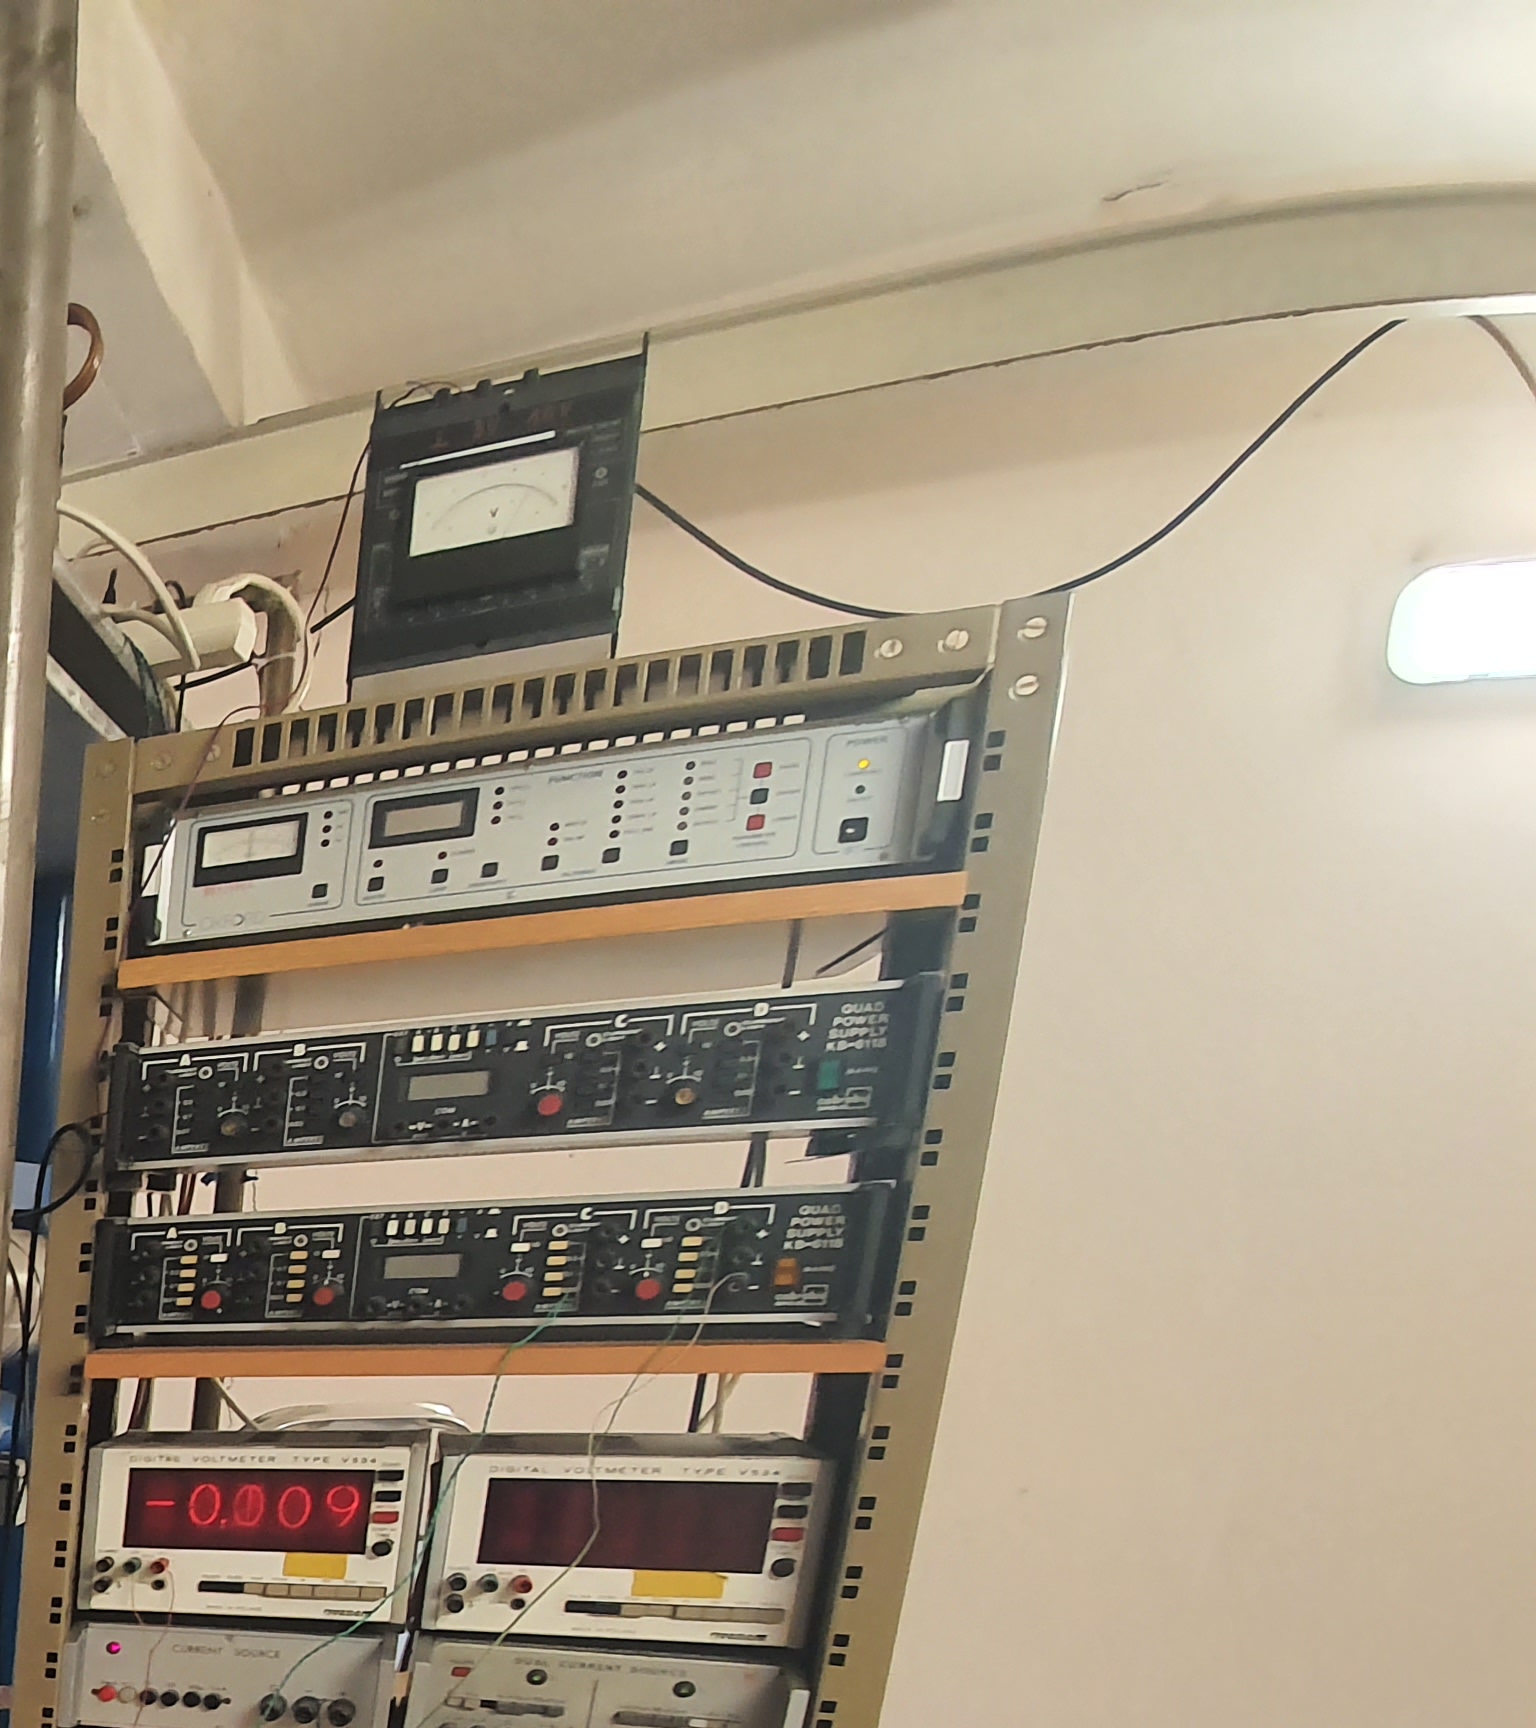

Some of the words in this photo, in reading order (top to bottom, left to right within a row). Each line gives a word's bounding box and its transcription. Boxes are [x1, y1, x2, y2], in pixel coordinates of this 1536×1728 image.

[547, 769, 604, 785] FUNCTION
[840, 1001, 885, 1015] QUAD
[614, 1014, 628, 1029] C
[832, 1013, 890, 1028] POWER
[828, 1025, 889, 1040] SUPPLY
[580, 1207, 593, 1221] C
[798, 1203, 842, 1216] QUAD
[790, 1215, 847, 1228] POWER
[786, 1227, 846, 1240] SUPPLY
[128, 1454, 182, 1464] DIGITAL
[192, 1454, 277, 1464] VOLTMETER
[292, 1455, 330, 1464] TYPE
[488, 1465, 548, 1474] DIGITAL
[563, 1466, 663, 1475] VOLTMETER
[682, 1467, 726, 1476] TYPE
[171, 1643, 224, 1655] CURRENT
[233, 1648, 280, 1659] SOURCE
[557, 1660, 622, 1672] CURRENT
[629, 1664, 688, 1677] SOURCE
